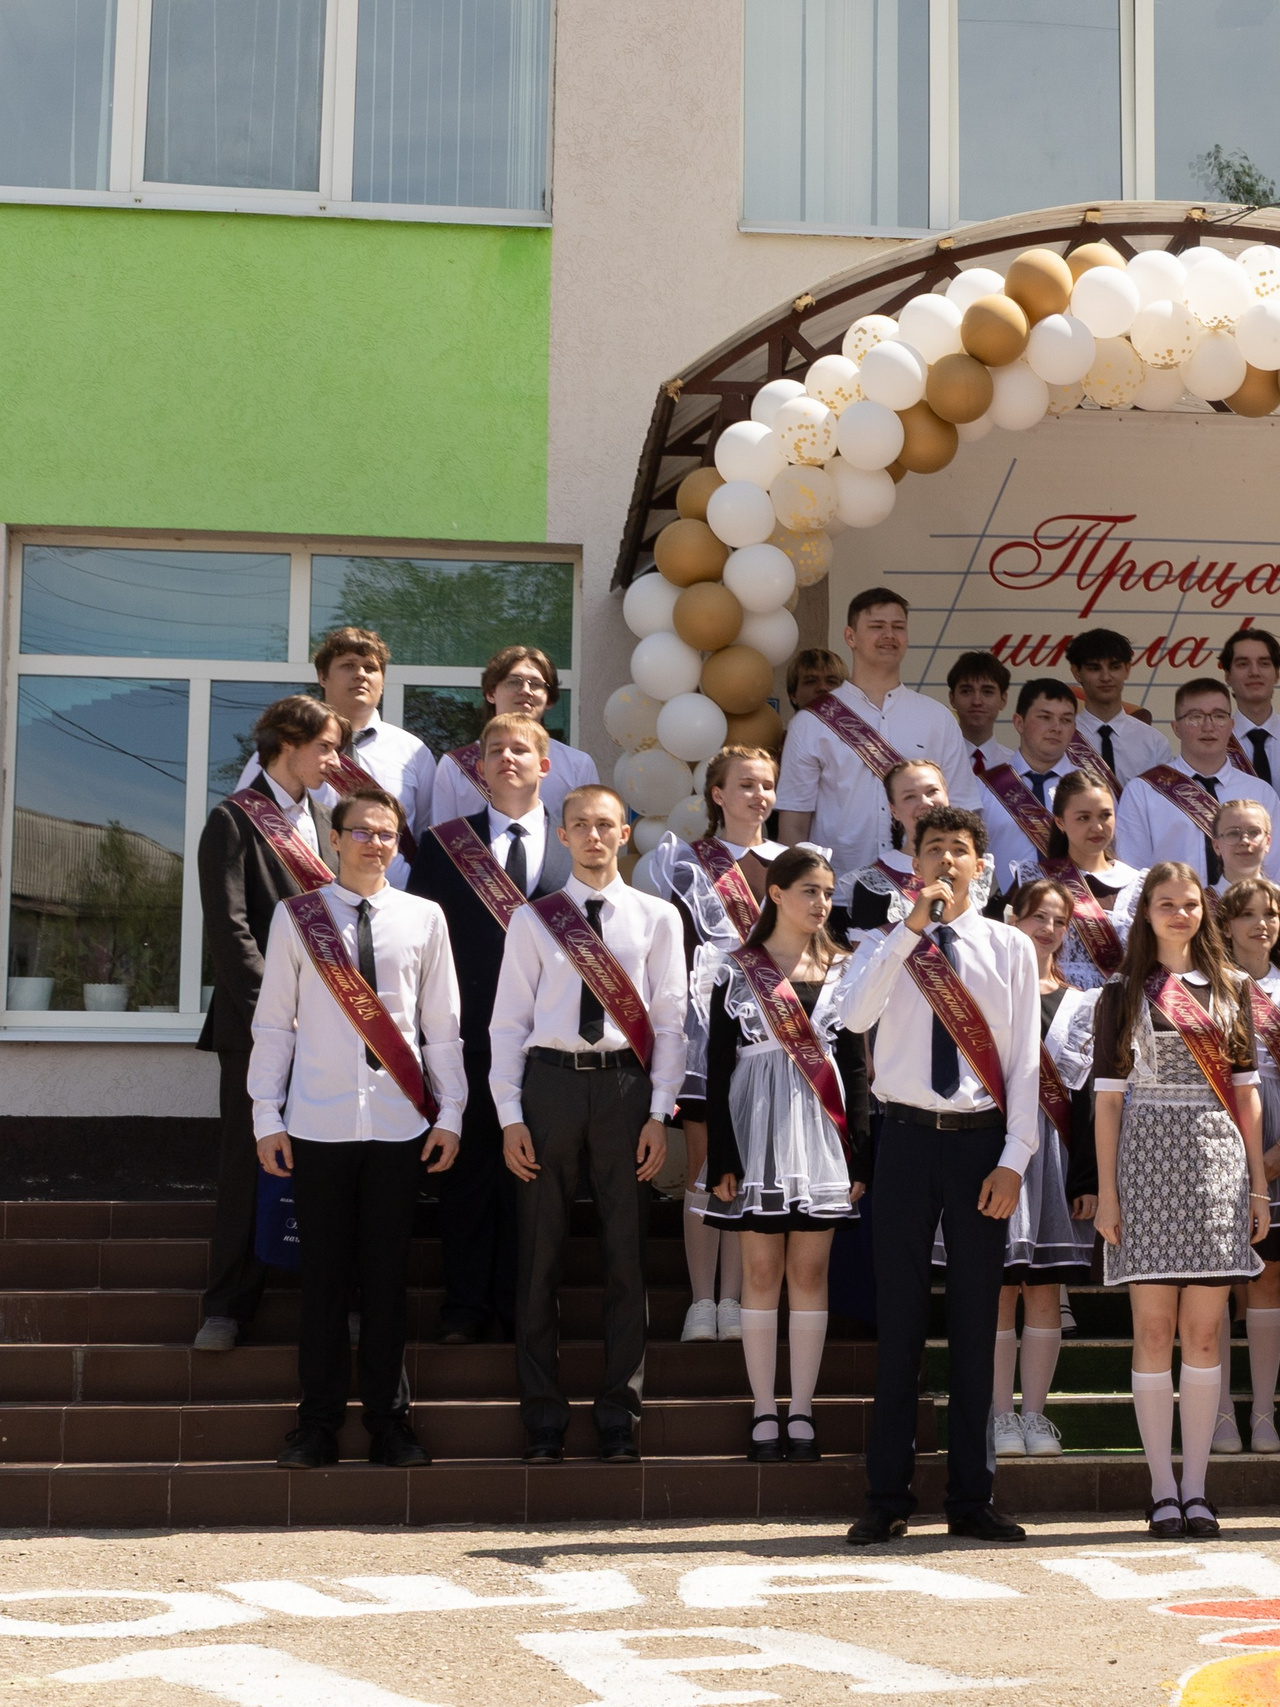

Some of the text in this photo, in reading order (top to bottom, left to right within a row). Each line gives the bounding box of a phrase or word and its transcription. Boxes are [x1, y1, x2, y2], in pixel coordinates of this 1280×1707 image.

[308, 923, 355, 992] Выпускник
[349, 992, 381, 1021] 2026
[565, 929, 620, 994] Выпускник
[615, 994, 642, 1022] 2026
[754, 967, 800, 1038] Выпускница
[795, 1039, 825, 1065] 2026
[913, 951, 968, 1022] Выпускник
[963, 1023, 993, 1052] 2026
[1161, 990, 1220, 1063] Выпускница
